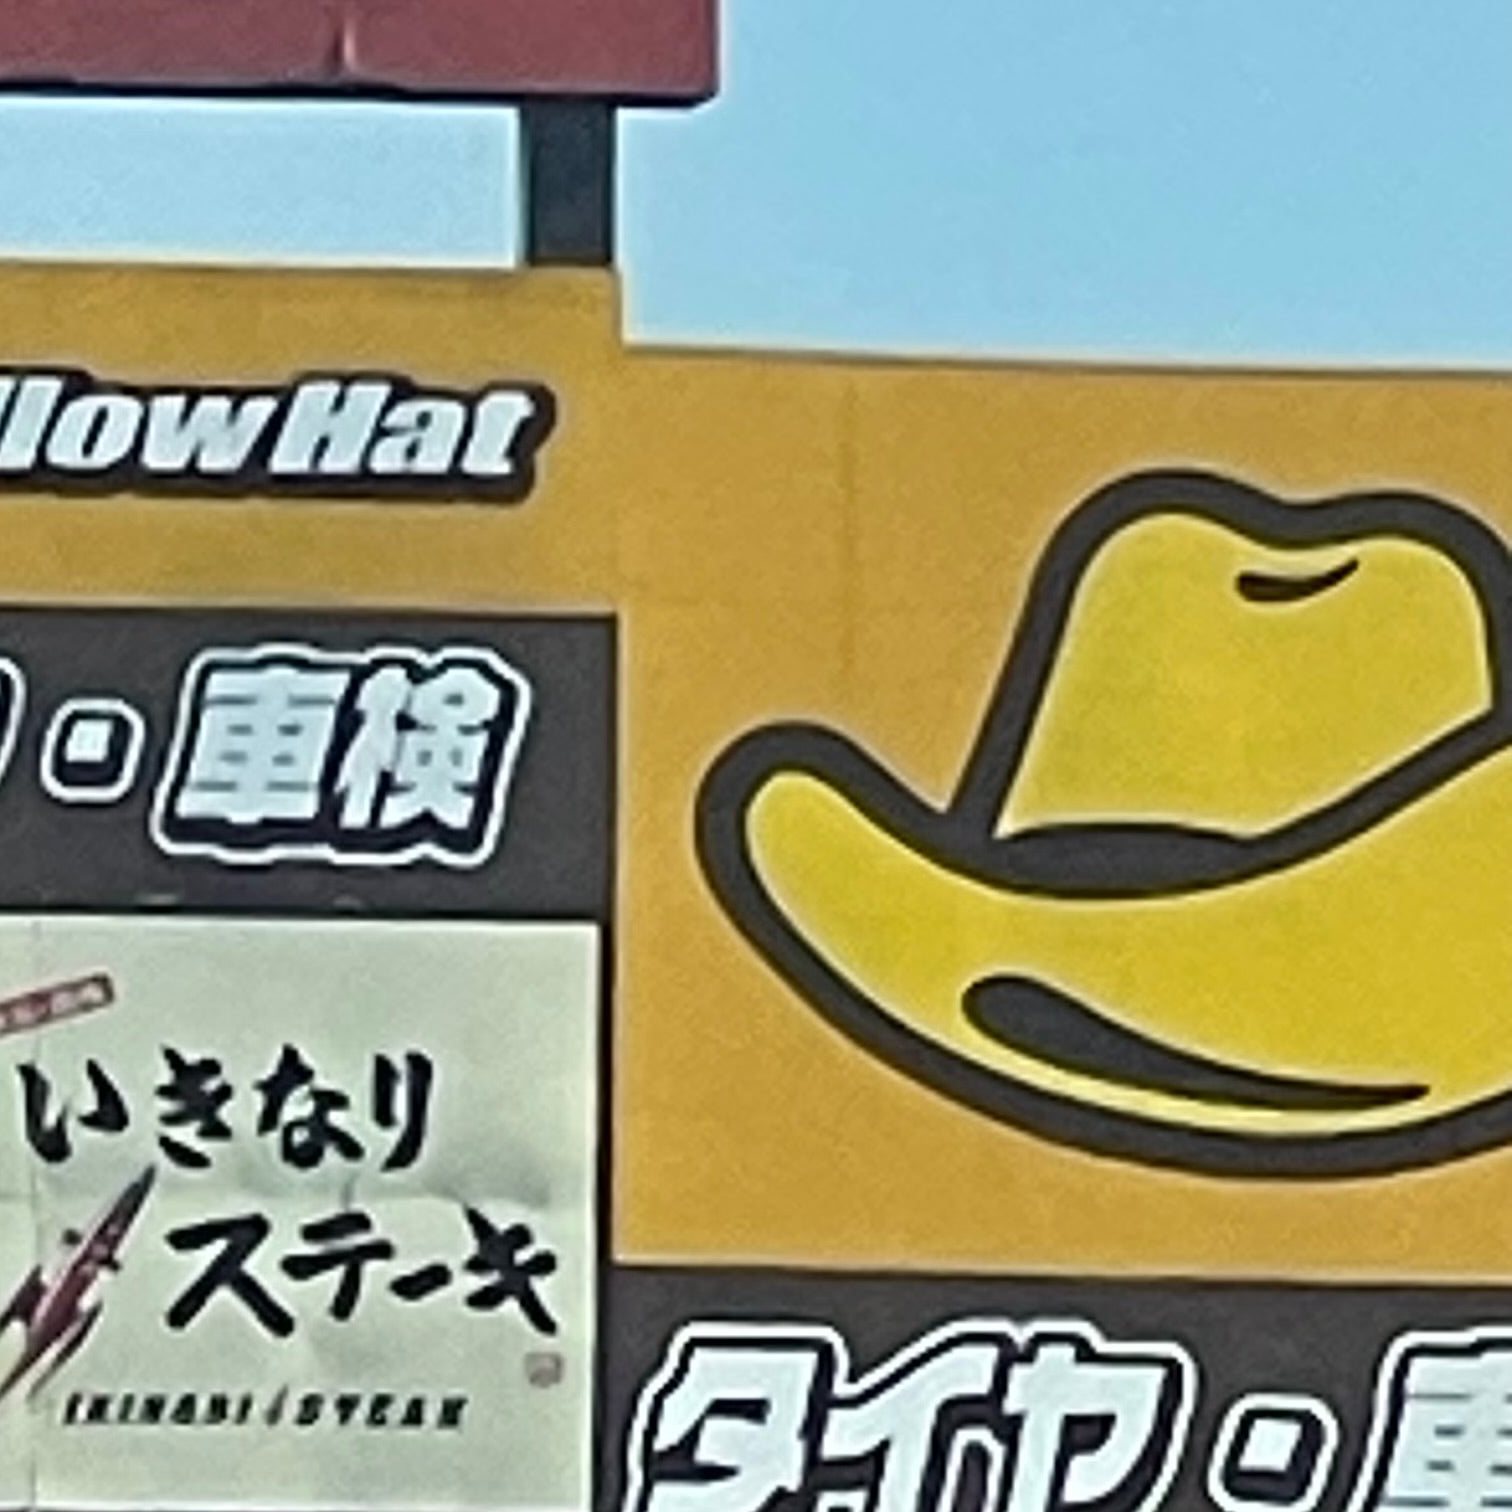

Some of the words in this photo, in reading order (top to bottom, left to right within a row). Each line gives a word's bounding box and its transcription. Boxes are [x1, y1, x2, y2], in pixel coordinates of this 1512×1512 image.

[16, 1043, 434, 1172] いきなり
[165, 1205, 559, 1338] ステーキ
